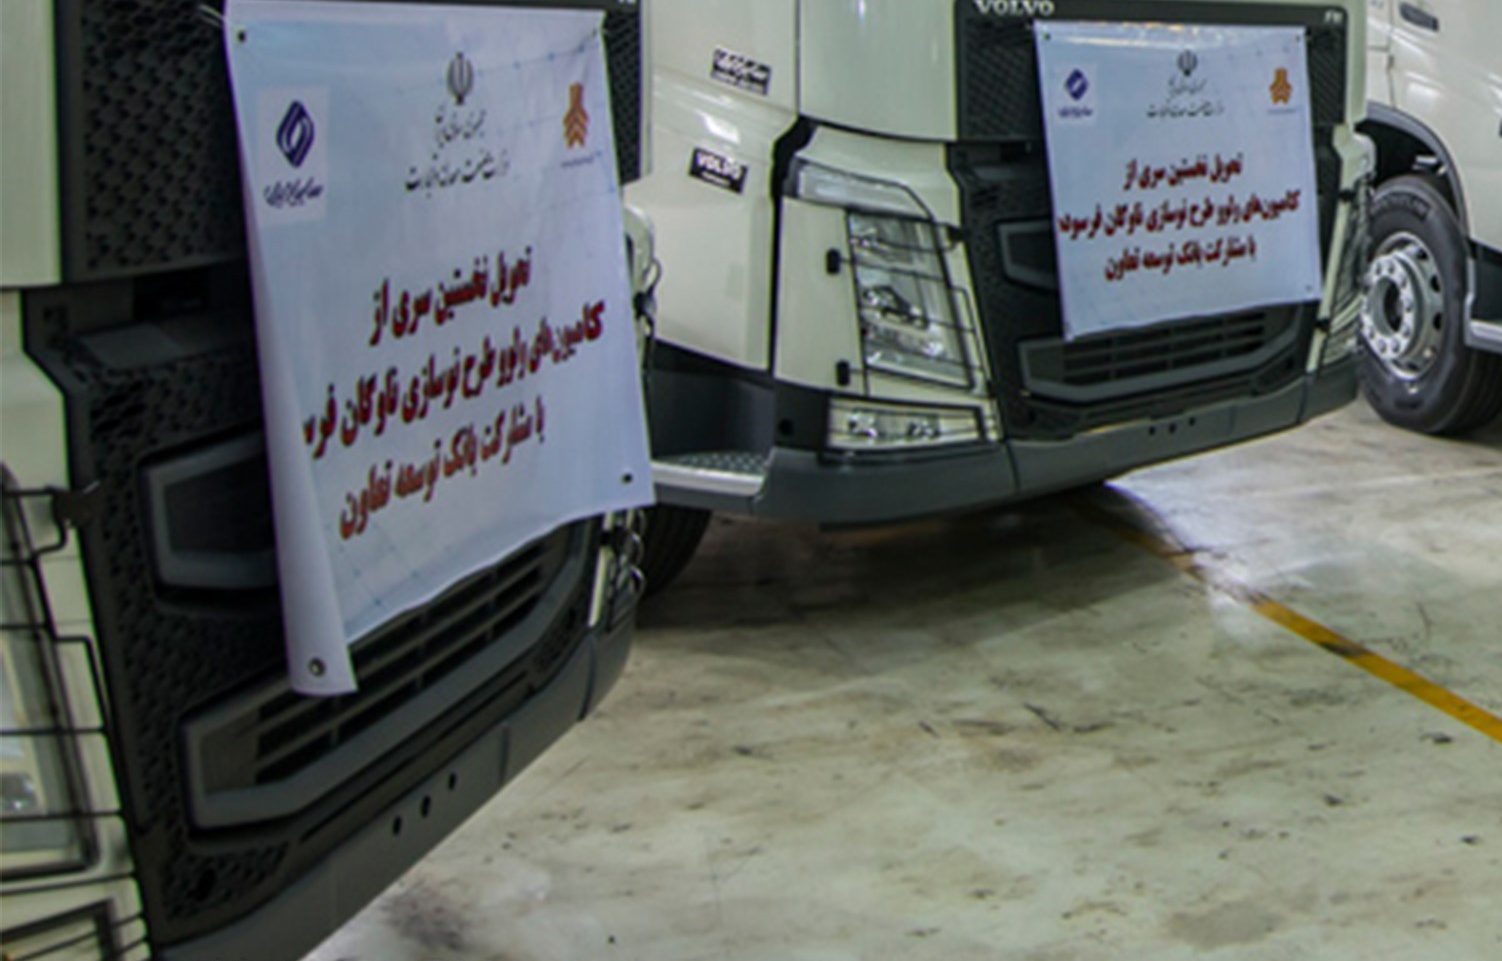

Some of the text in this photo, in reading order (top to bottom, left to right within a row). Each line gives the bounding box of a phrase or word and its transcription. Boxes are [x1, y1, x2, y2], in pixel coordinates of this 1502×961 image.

[369, 277, 390, 347] از
[391, 288, 433, 339] سری
[462, 335, 496, 399] طرح
